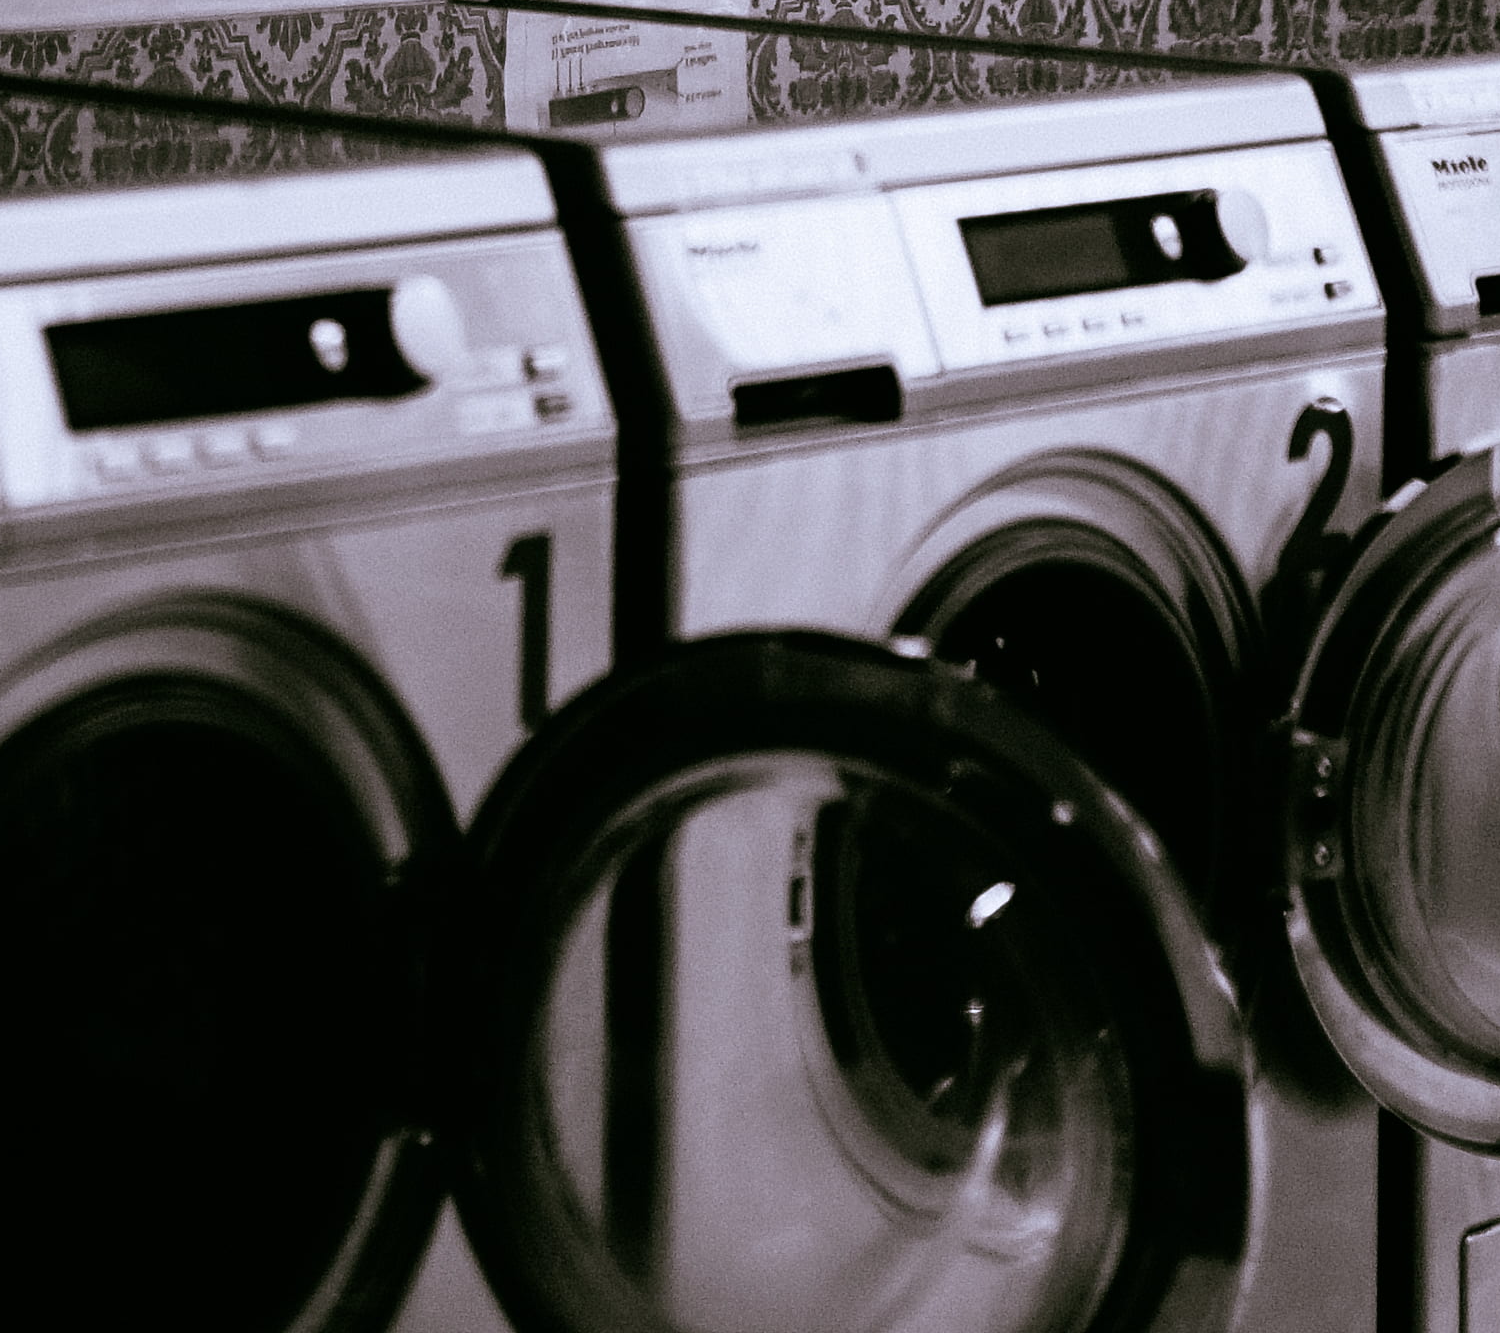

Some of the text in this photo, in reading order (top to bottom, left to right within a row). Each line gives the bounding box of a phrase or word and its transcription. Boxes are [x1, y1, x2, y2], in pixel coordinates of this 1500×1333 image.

[1431, 155, 1488, 176] Miele
[1278, 397, 1353, 579] 2
[498, 532, 552, 733] 1
